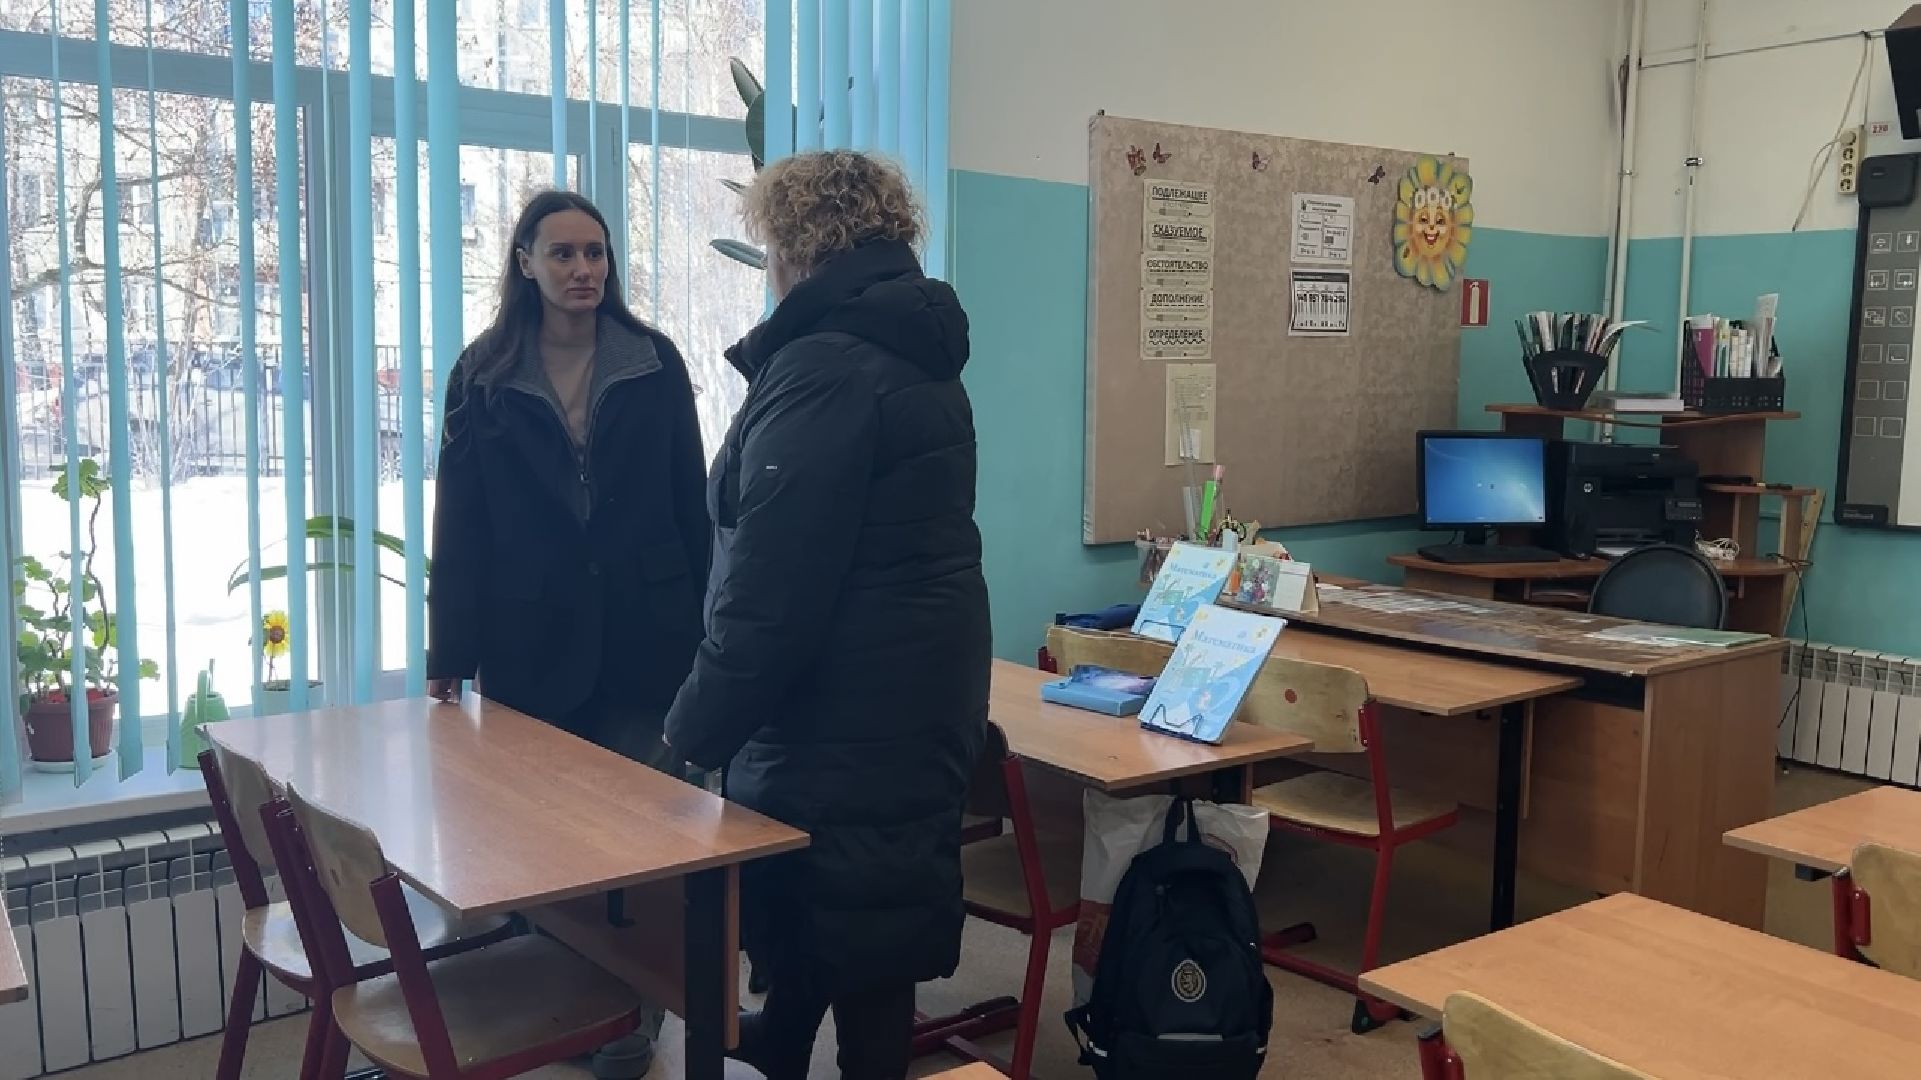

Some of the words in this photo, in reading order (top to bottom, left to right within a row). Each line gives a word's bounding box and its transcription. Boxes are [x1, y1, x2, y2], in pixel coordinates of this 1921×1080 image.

[1152, 185, 1208, 201] ПОДЛЕЖАЩЕЕ
[1153, 224, 1204, 238] СКАЗУЕМОЕ
[1146, 259, 1209, 270] ОБСТОЯТЕЛЬСТВО
[1150, 293, 1204, 305] ДОПОЛНЕНИЕ
[1148, 329, 1203, 339] ОПРЕДЕЛЕНИЕ
[1170, 561, 1217, 579] Математика
[1194, 629, 1257, 654] Математика
